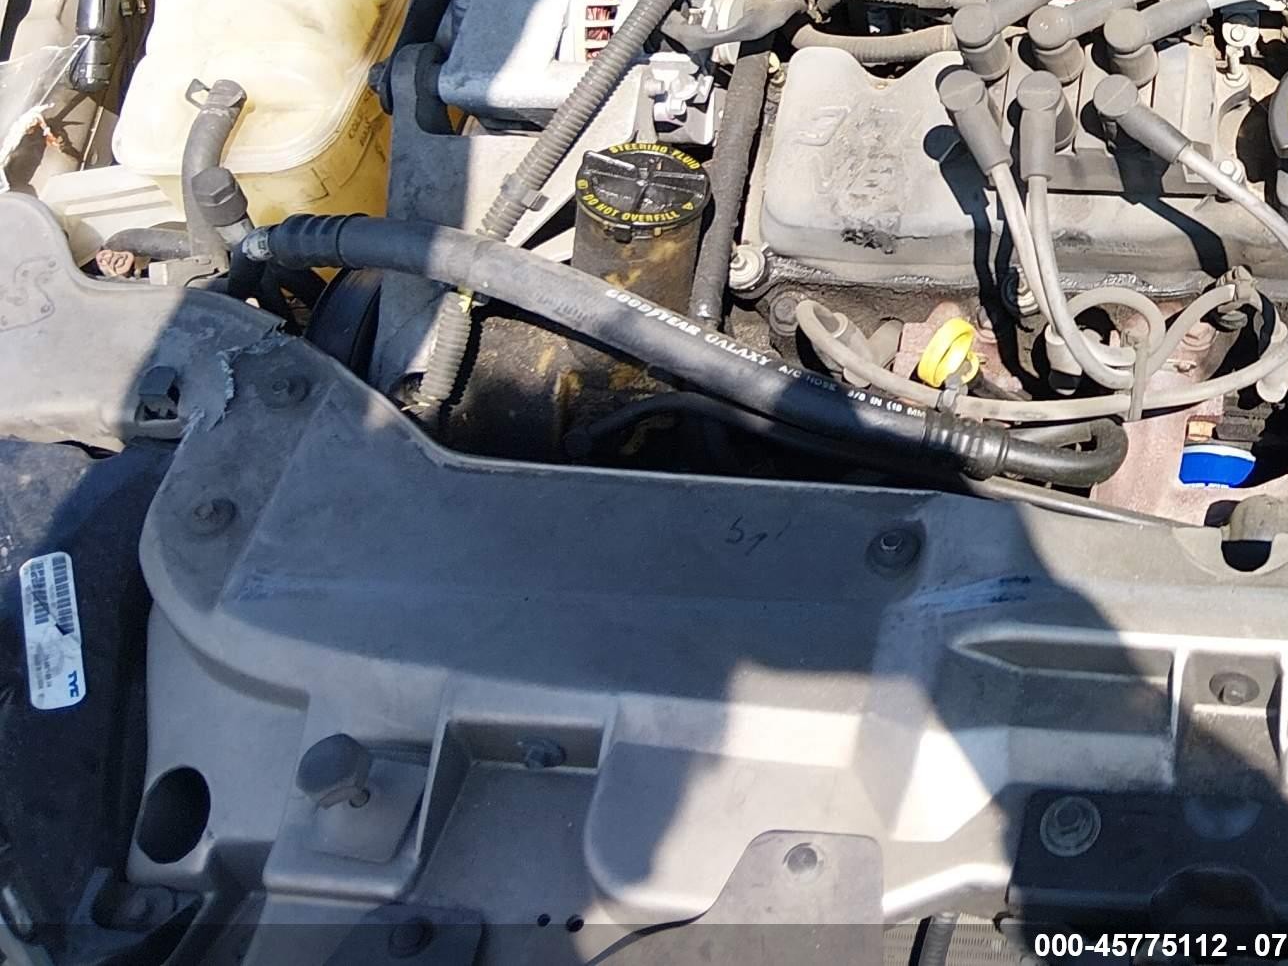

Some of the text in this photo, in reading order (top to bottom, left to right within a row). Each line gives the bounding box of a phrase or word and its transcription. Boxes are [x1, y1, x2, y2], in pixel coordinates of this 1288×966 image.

[608, 143, 701, 170] STEERING FLUID
[582, 194, 680, 222] DO NOT OVERFILL
[605, 289, 701, 335] GOODYEAR
[704, 334, 772, 366] GALAXY
[779, 365, 803, 378] A/C
